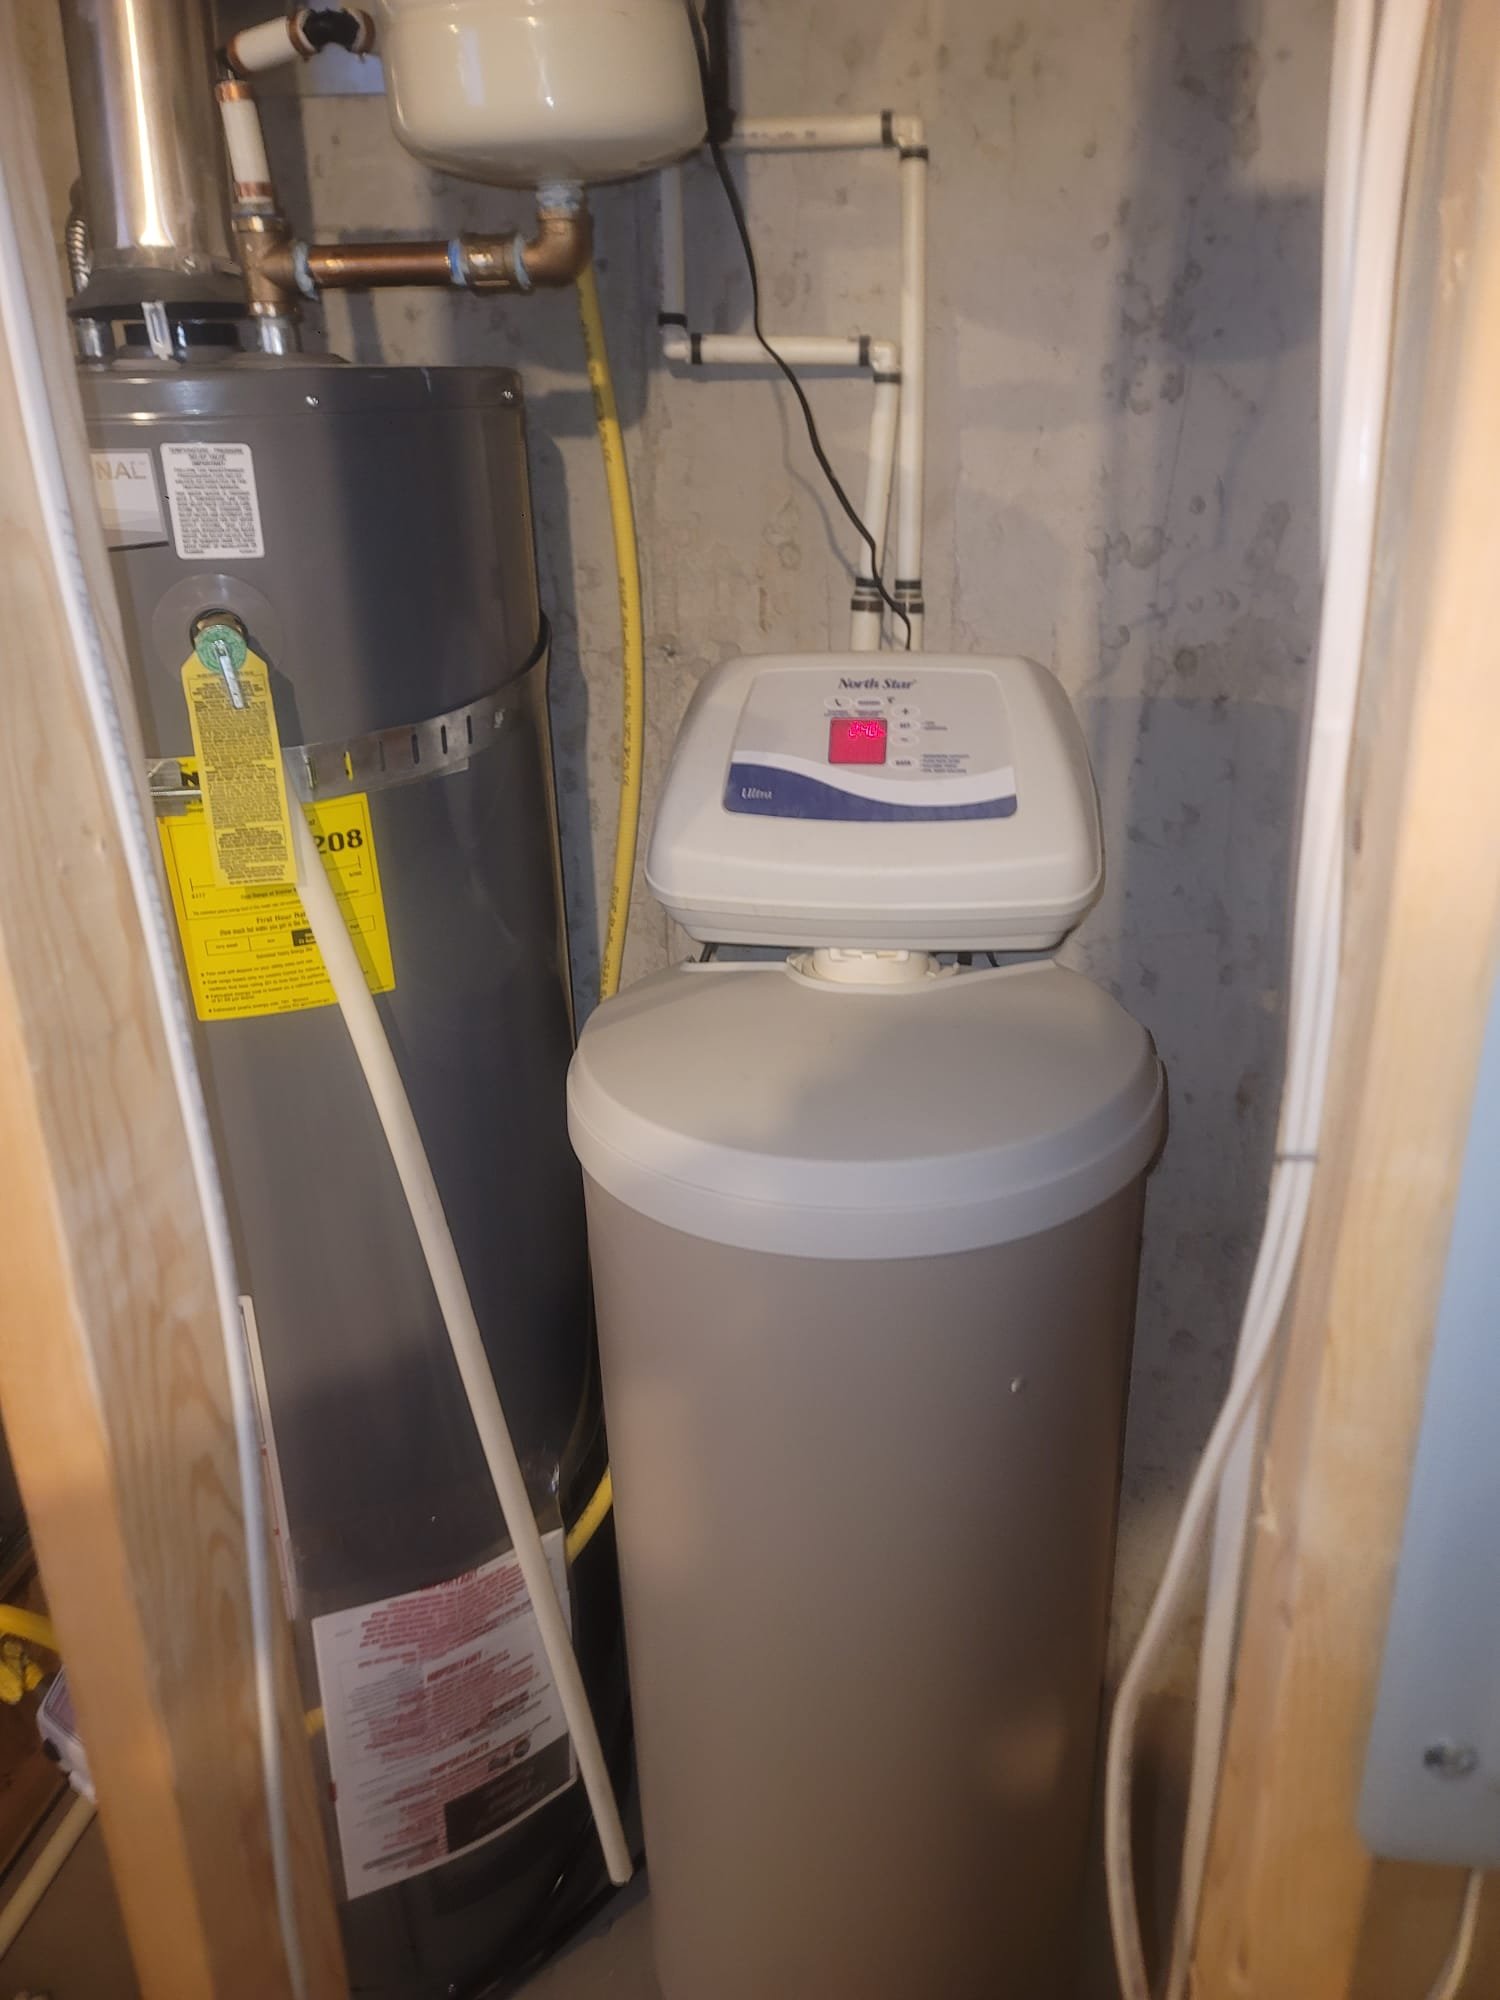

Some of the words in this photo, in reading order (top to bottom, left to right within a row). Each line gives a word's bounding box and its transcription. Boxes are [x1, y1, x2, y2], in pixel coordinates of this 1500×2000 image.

[838, 678, 879, 689] North
[882, 678, 912, 689] Star
[741, 787, 773, 799] Ultra
